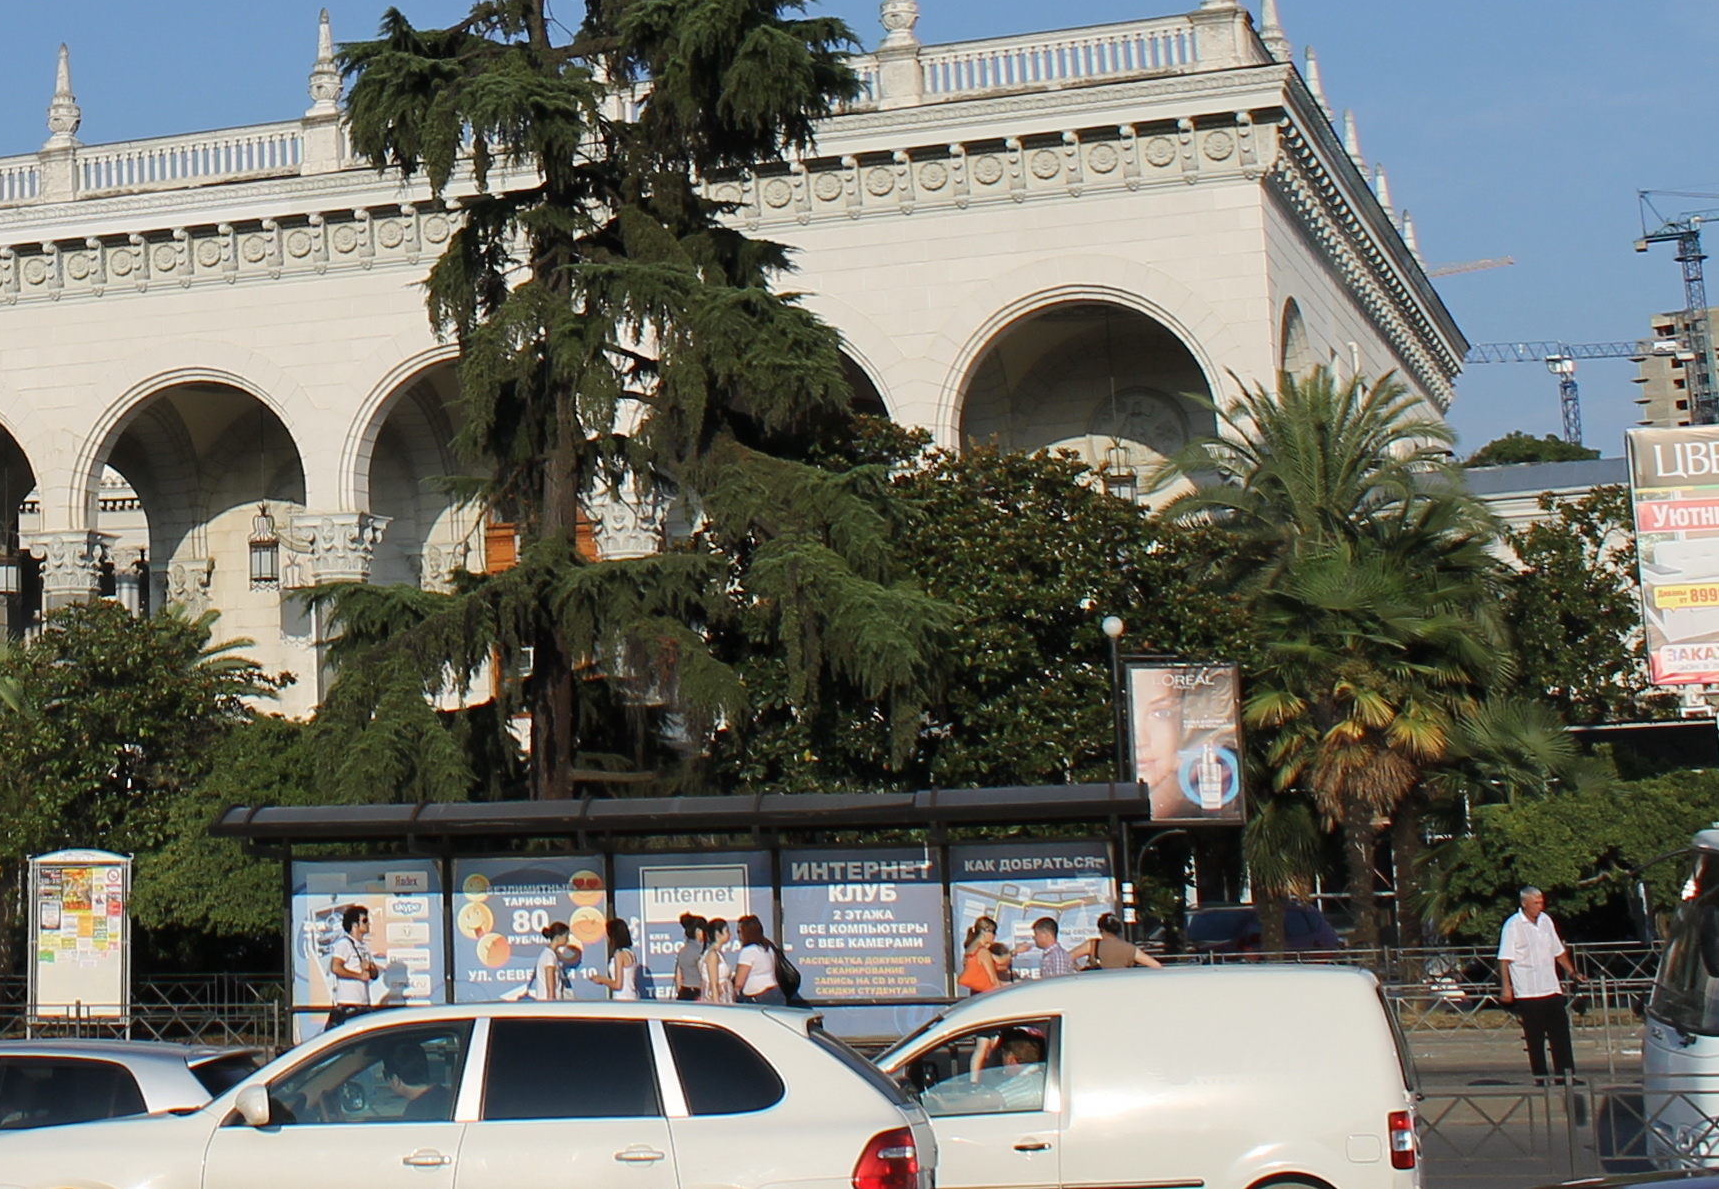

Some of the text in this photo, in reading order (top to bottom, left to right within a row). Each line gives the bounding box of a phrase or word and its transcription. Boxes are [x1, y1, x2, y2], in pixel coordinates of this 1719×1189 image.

[1667, 647, 1719, 662] ЗАКА
[792, 861, 931, 881] ИНТЕРНЕТ
[964, 860, 995, 872] КАК
[654, 886, 735, 903] Internet
[828, 884, 897, 902] КЛУБ
[394, 901, 421, 913] skype
[503, 896, 557, 906] ТАРИФЫ!
[512, 909, 549, 933] 80
[833, 910, 894, 920] 2 ЭТАЖА
[799, 923, 928, 935] ВСЕ КОМПЬЮТЕРЫ
[507, 935, 551, 945] РУБ/ЧА
[805, 937, 923, 948] С ВЕБ КАМЕРАМИ
[799, 956, 931, 965] РАСПЕЧАТКА ДОКУМЕНТОВ
[468, 970, 492, 982] УЛ.
[580, 967, 598, 979] 10
[825, 966, 905, 975] СКАНИРОВАНИЕ
[814, 977, 853, 985] ЗАПИСЬ
[856, 977, 870, 985] НА
[872, 977, 885, 985] CD
[897, 977, 917, 985] DVD
[815, 987, 917, 996] СКИДКИ СТУДЕНТАМ
